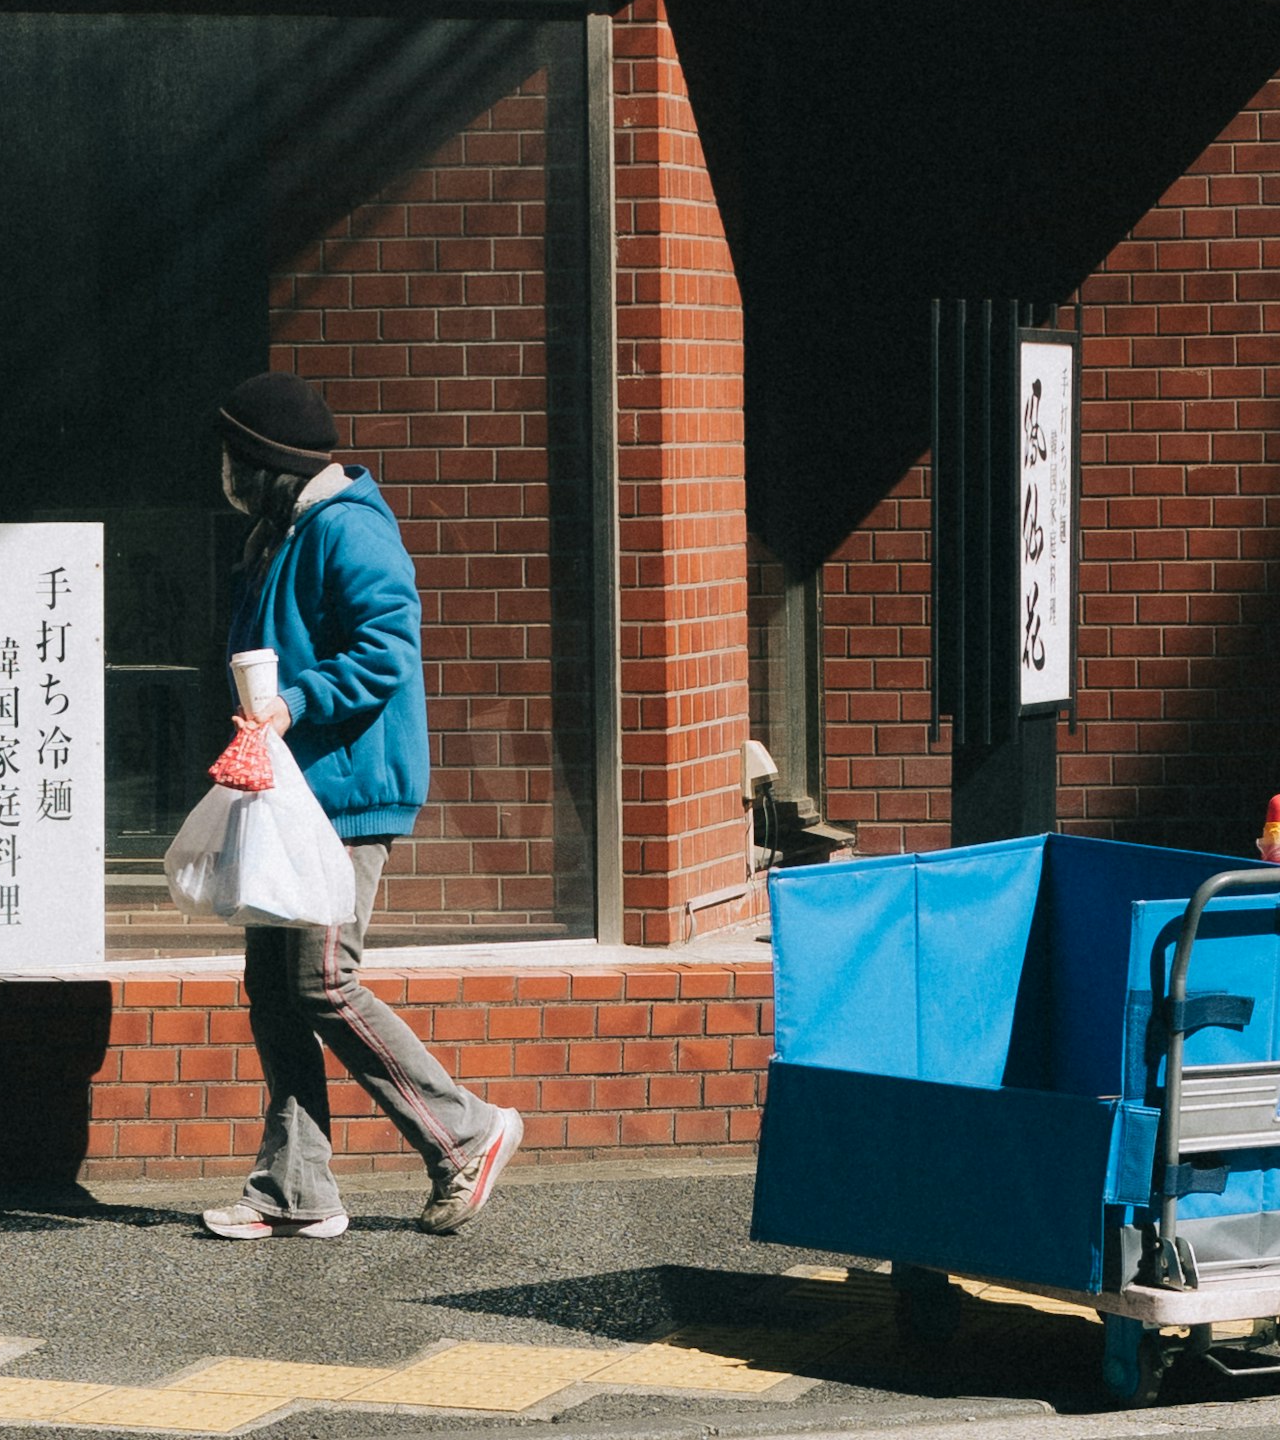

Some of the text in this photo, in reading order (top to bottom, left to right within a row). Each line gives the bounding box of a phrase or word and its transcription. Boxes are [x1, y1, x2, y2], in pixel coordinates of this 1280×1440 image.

[35, 566, 72, 822] 手打ち冷麺
